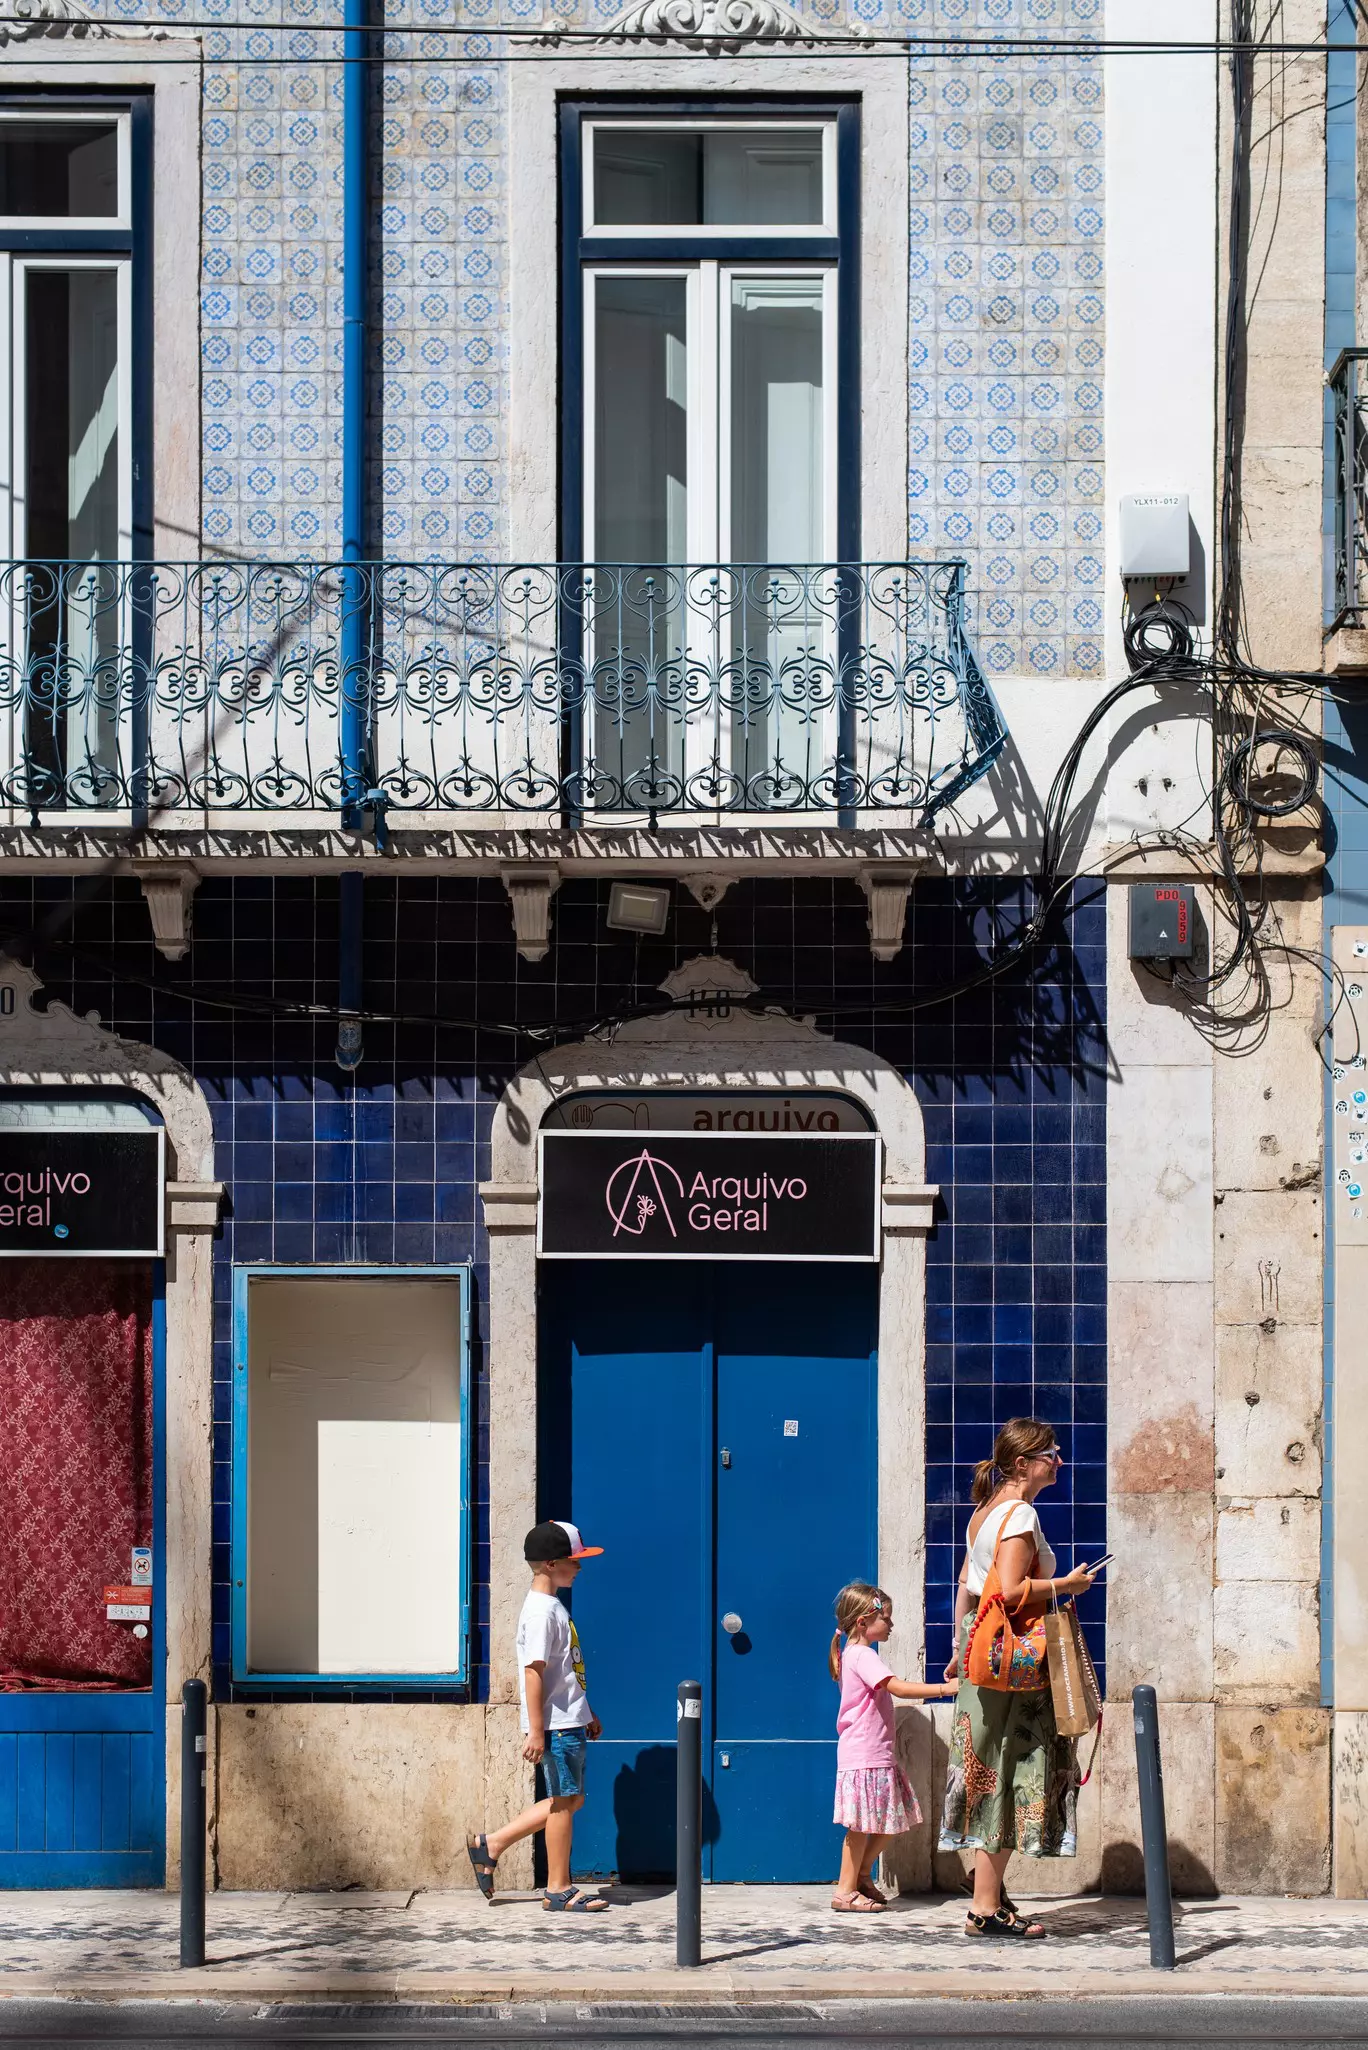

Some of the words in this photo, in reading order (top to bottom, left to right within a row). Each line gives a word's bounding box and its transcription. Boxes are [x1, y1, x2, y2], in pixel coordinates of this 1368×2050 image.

[1133, 497, 1179, 506] YLX11-012
[1179, 900, 1187, 943] 9359
[689, 1171, 808, 1207] Arquivo
[688, 1202, 768, 1232] Geral
